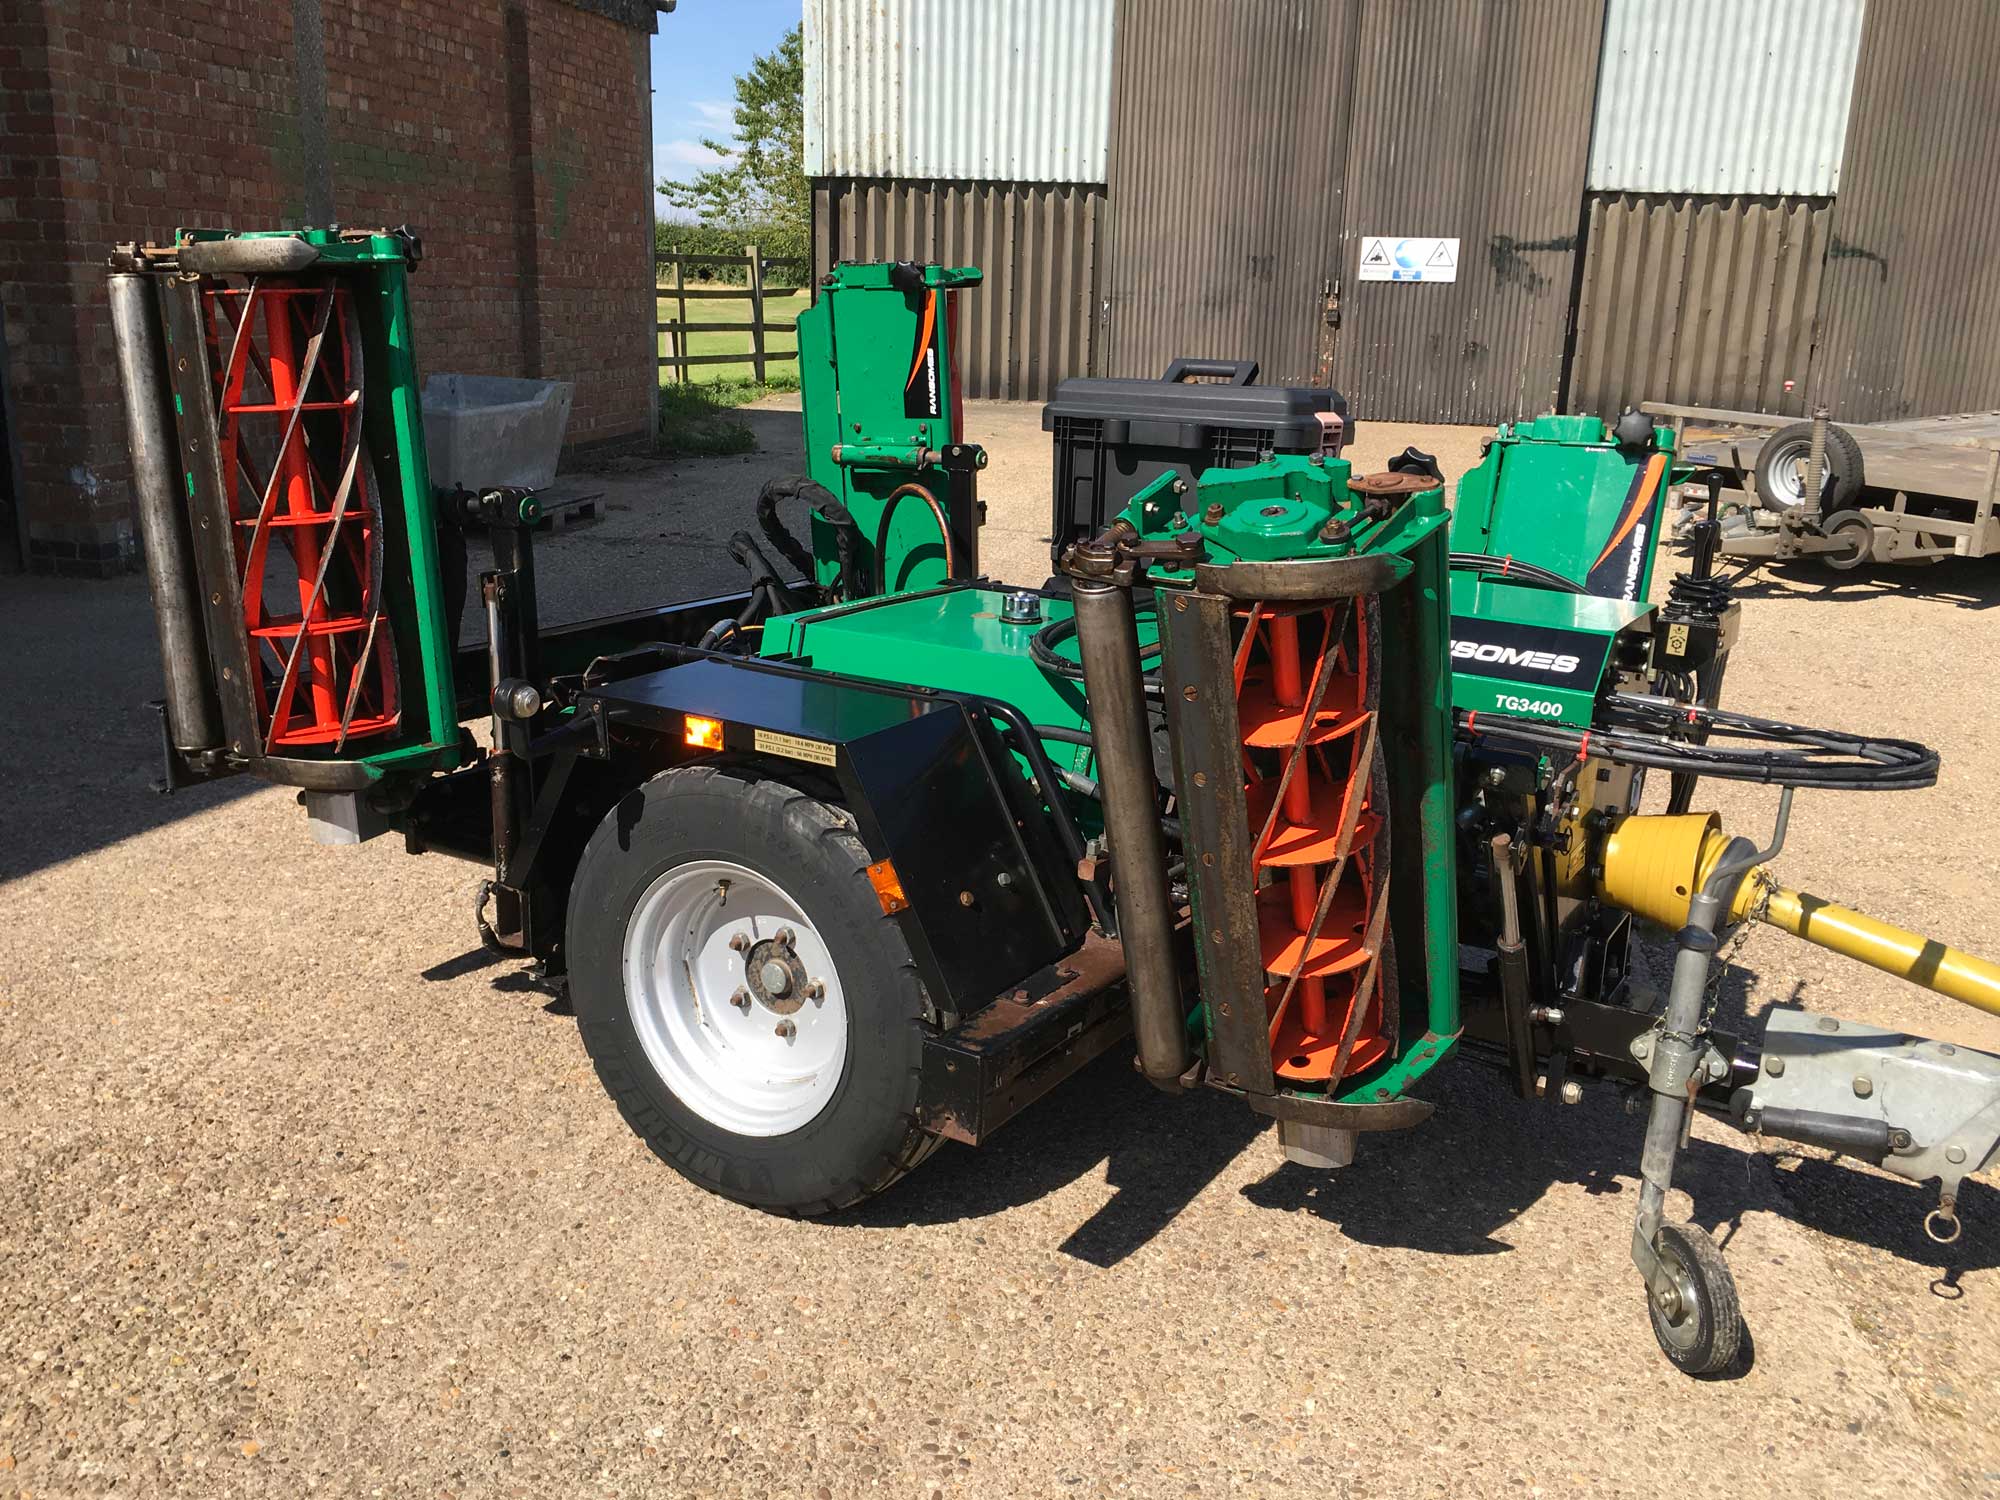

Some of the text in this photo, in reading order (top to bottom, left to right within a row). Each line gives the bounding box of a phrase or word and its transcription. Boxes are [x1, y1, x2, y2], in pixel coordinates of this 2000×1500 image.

[926, 348, 937, 415] RANSOMES
[1451, 639, 1580, 673] SOMES
[1495, 694, 1563, 717] TG3400
